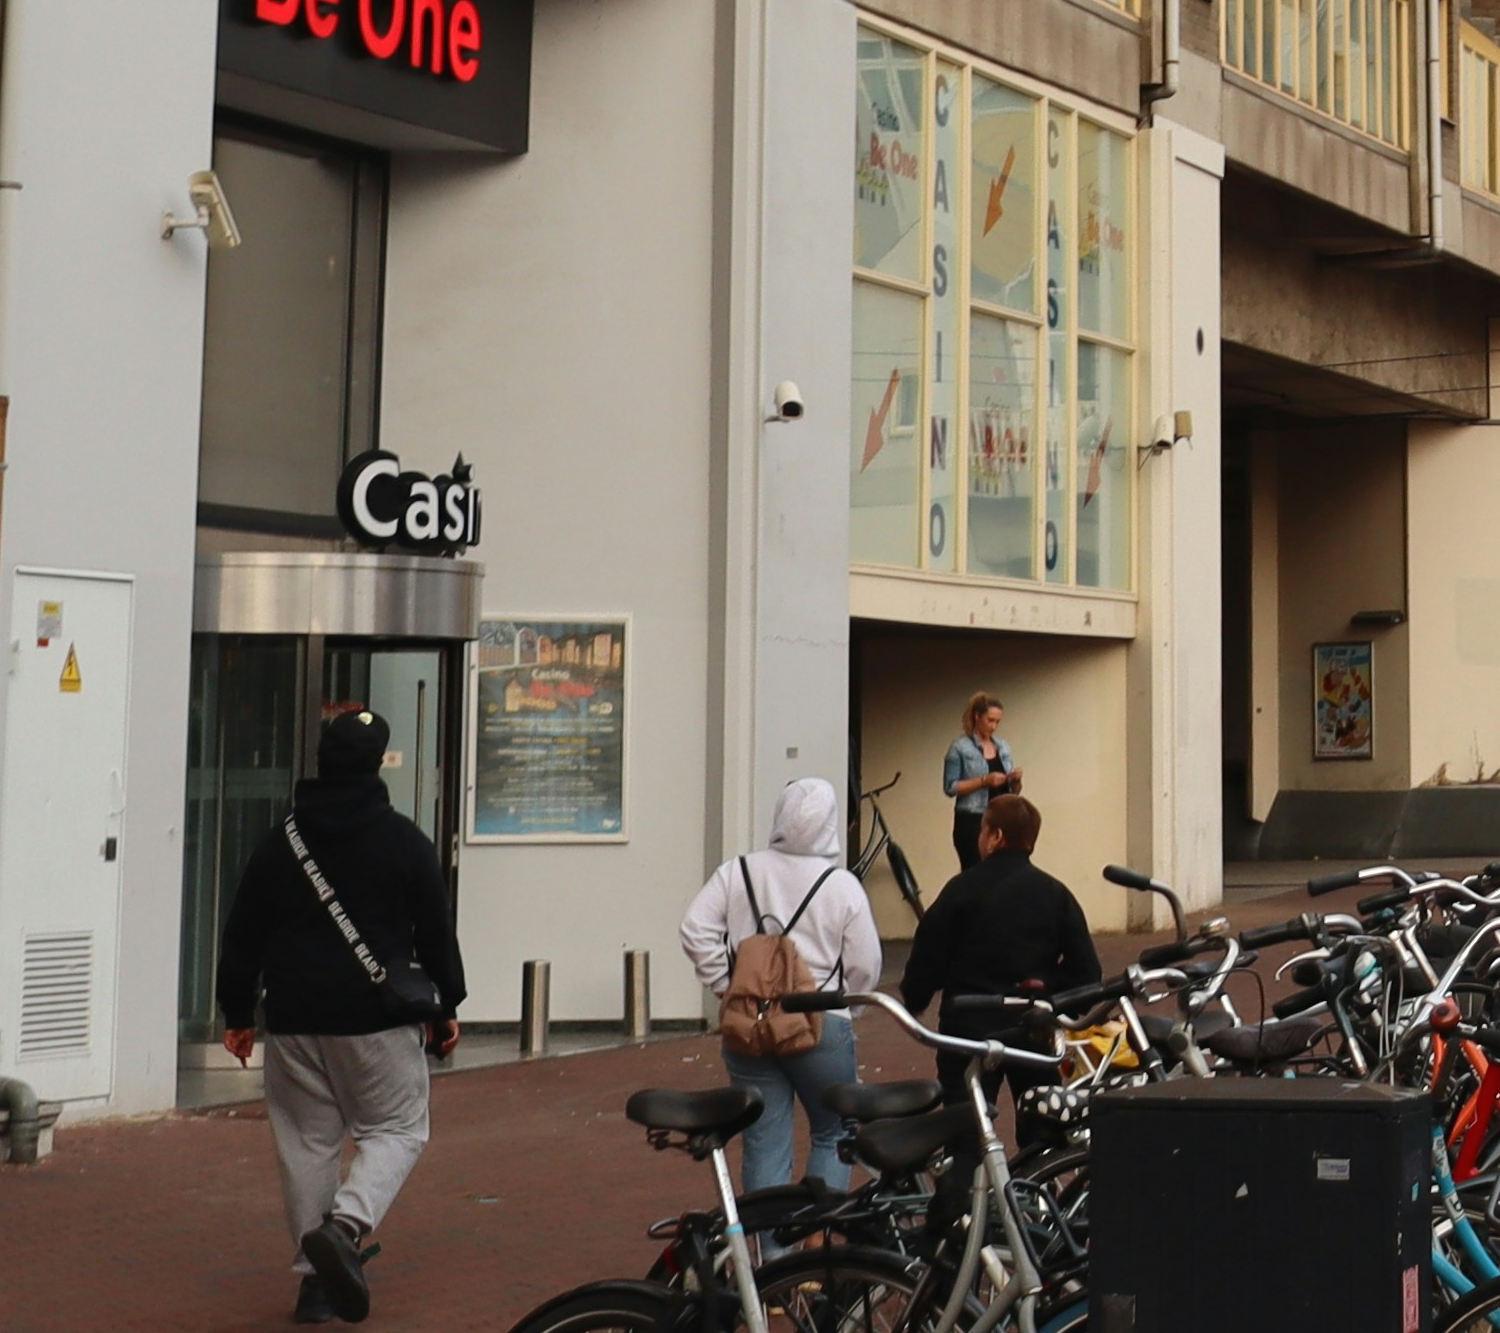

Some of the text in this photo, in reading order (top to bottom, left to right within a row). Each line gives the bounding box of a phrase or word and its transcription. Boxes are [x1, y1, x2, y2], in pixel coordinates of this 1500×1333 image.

[870, 132, 919, 181] Be One
[929, 73, 950, 558] CASINO
[1045, 119, 1060, 572] CASINO
